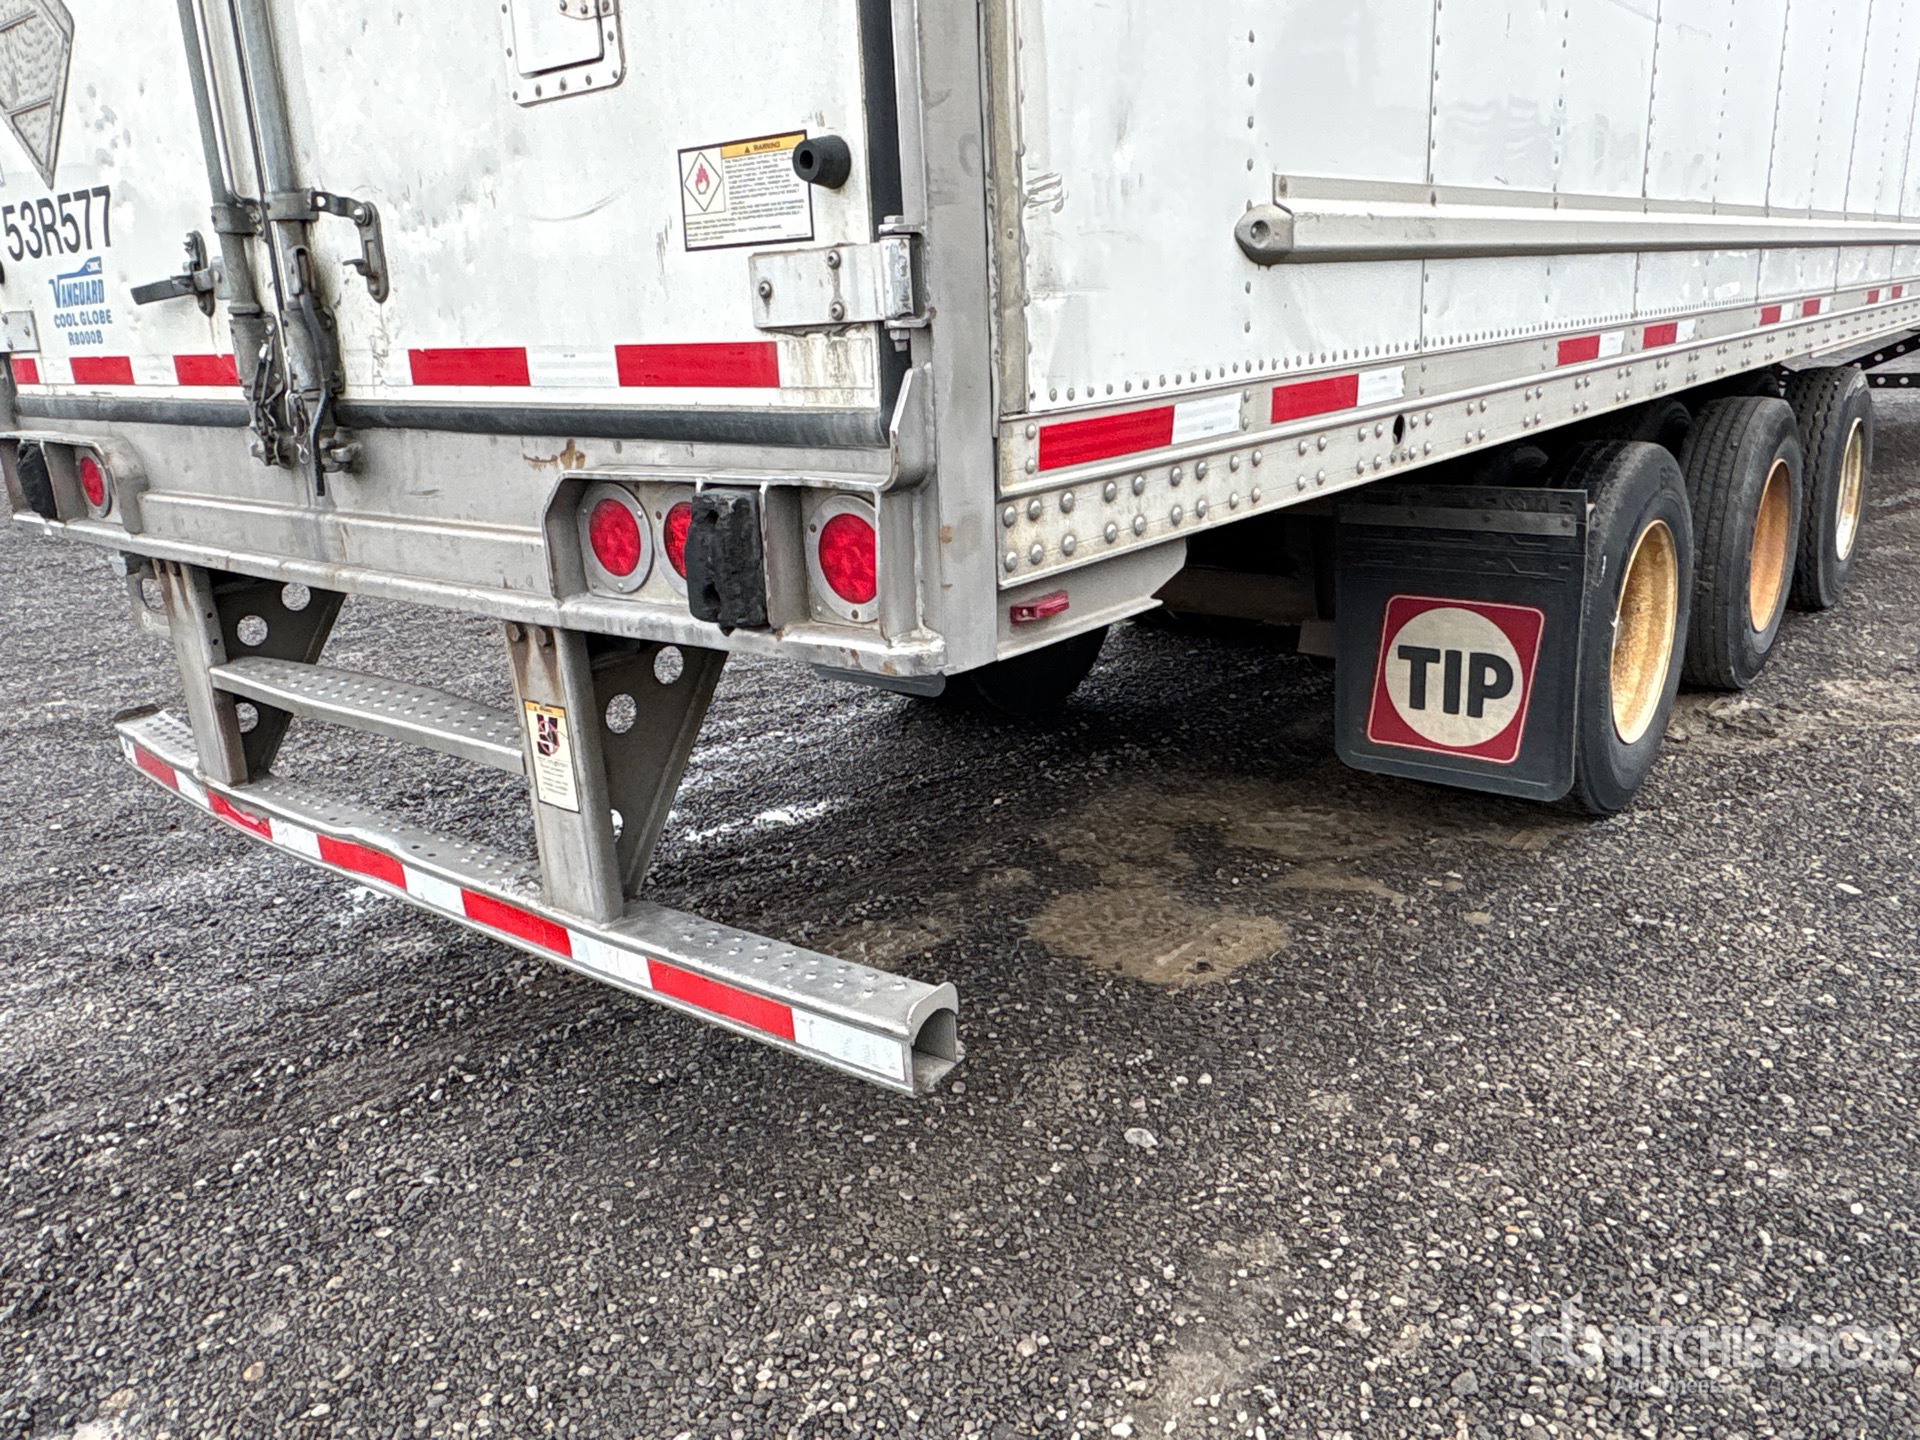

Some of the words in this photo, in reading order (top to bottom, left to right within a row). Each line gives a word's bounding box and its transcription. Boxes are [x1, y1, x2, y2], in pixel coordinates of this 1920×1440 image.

[1, 185, 111, 261] 53R577
[48, 278, 105, 308] VANGUARD
[54, 312, 79, 328] COOL
[80, 309, 113, 326] GLOBE
[1397, 644, 1514, 718] TIP
